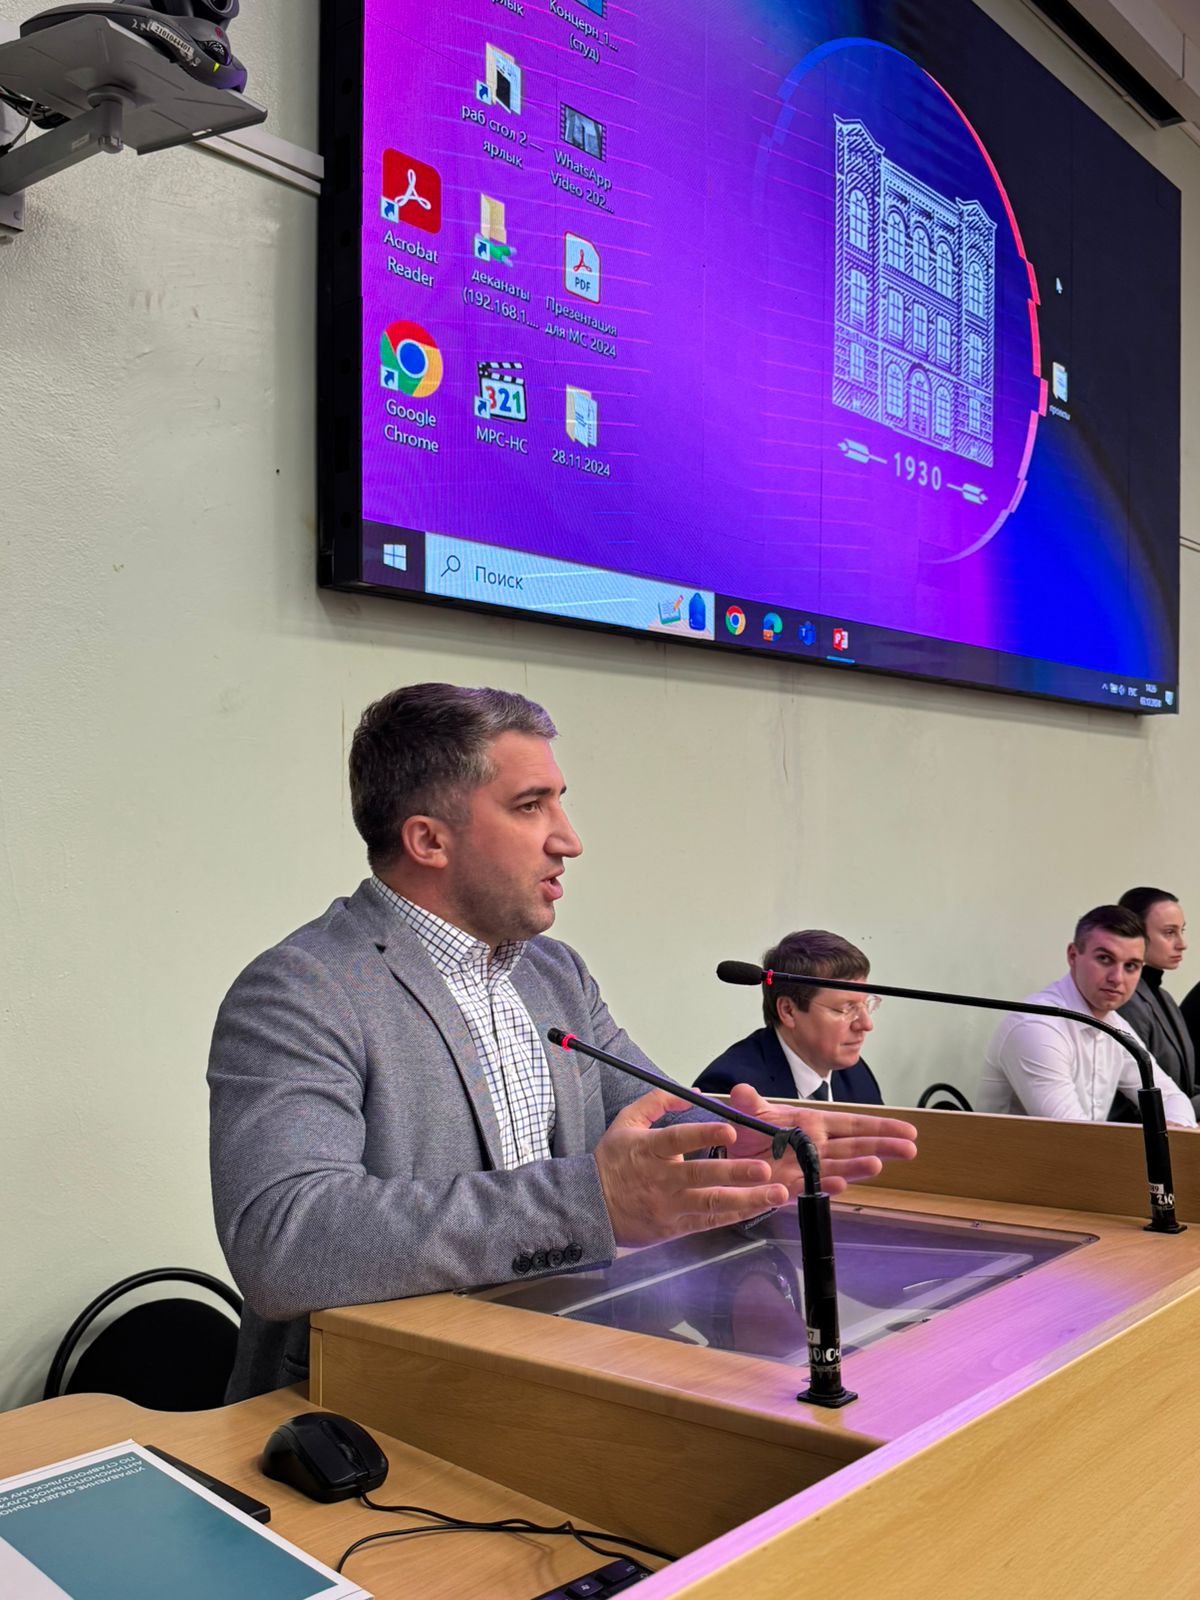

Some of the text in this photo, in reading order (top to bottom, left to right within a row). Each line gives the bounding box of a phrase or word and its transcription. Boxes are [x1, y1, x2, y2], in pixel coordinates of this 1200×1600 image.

[569, 33, 599, 63] (студ)
[462, 105, 485, 125] раб
[489, 120, 516, 143] стол
[519, 131, 527, 146] 2
[483, 140, 522, 168] ярлык
[554, 149, 612, 190] WhatsApp
[551, 170, 614, 213] Video 202...
[383, 230, 438, 264] Acrobat
[387, 256, 434, 287] Reader
[472, 269, 531, 301] деканаты
[575, 277, 591, 292] PDF
[545, 296, 617, 336] Презентация
[545, 322, 617, 357] для МС 2024
[386, 399, 437, 427] Google
[384, 425, 439, 453] Chrome
[477, 426, 528, 453] MPC-HC
[552, 449, 611, 477] 28.11.2024
[894, 452, 942, 490] 1930
[475, 566, 523, 590] Поиск
[118, 1456, 136, 1465] ПО
[11, 1462, 119, 1498] СТАВРОПОЛЬСКОМУ
[29, 1460, 143, 1499] АНТИМОНОПОЛЬНОЙ
[79, 1466, 146, 1491] УПРАВЛЕНИЕ
